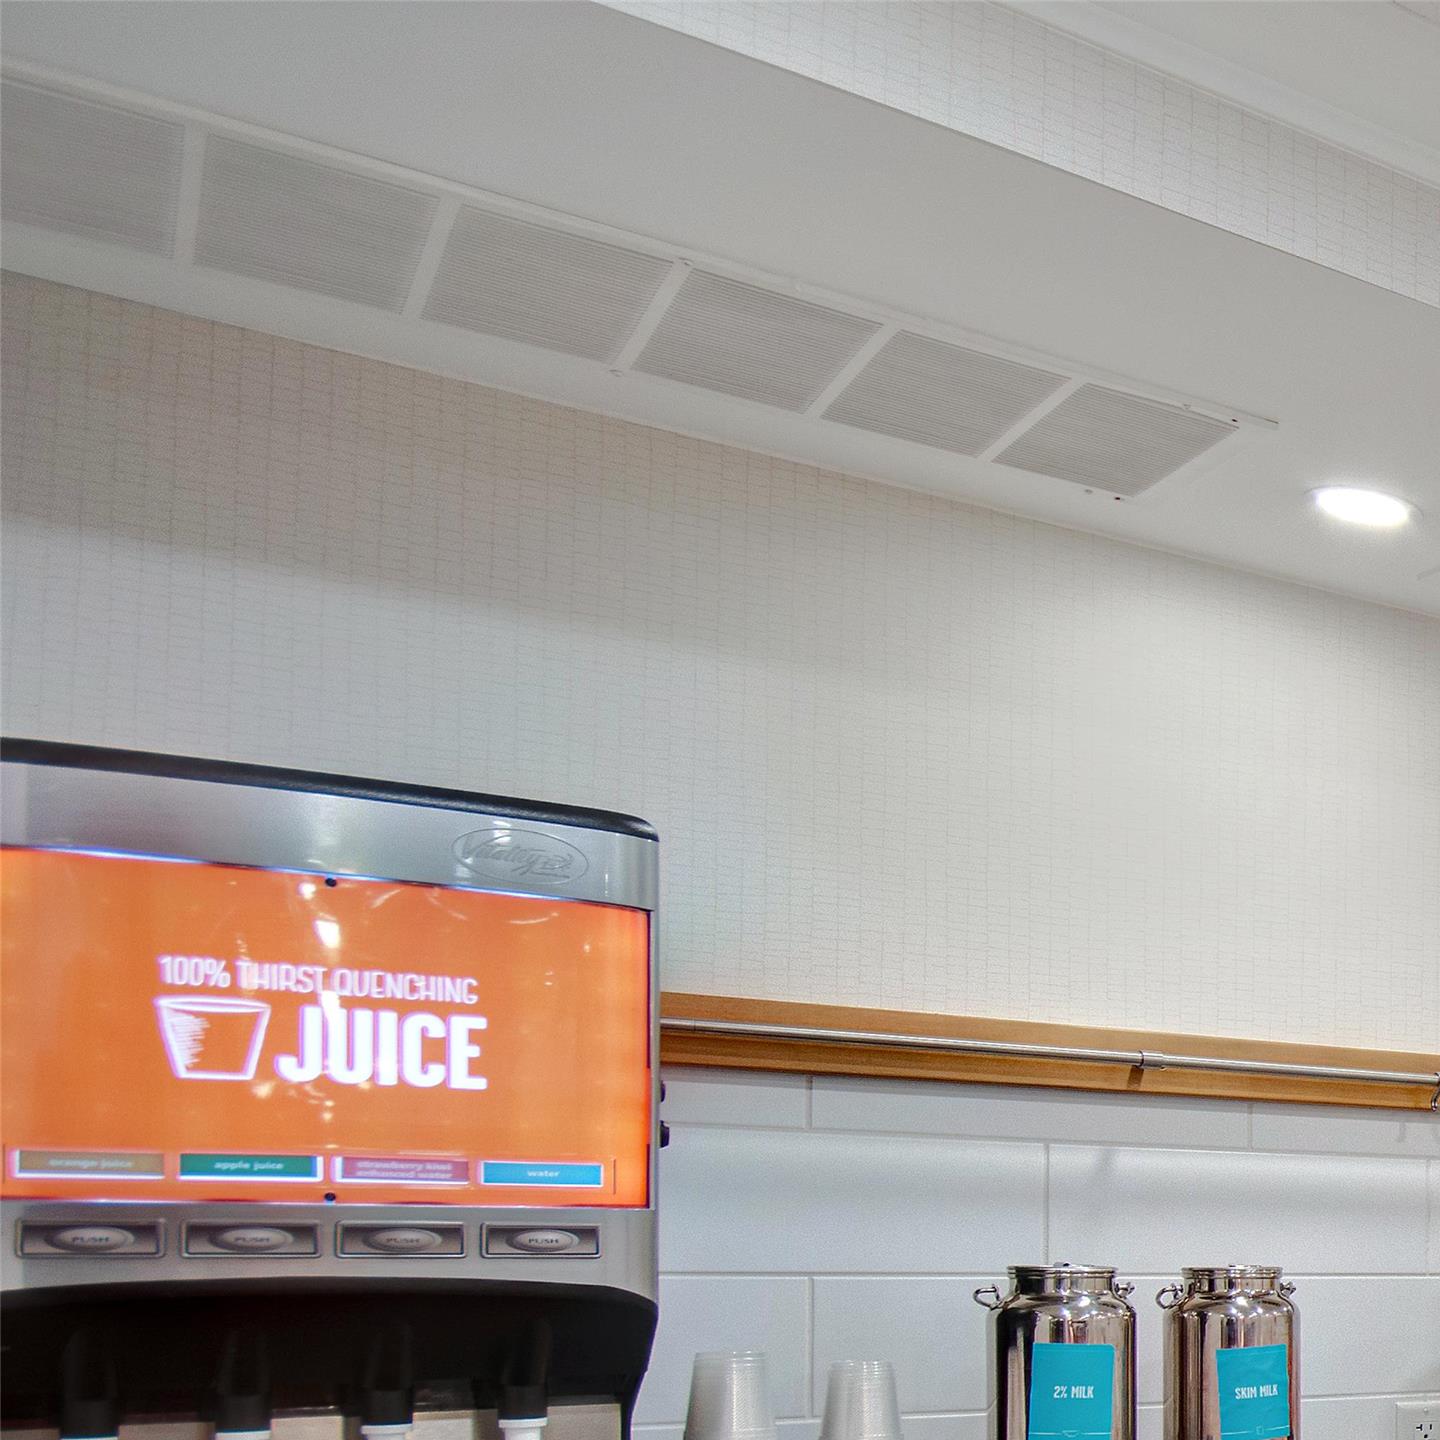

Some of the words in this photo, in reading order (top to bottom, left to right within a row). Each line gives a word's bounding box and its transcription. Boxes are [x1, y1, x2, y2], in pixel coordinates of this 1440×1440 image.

[158, 955, 231, 988] 100%
[236, 958, 328, 993] THIRST
[332, 967, 479, 1005] QUENCHING
[275, 1005, 488, 1090] JUICE
[214, 1161, 250, 1172] apple
[253, 1160, 285, 1171] juice
[527, 1169, 561, 1177] water
[72, 1235, 110, 1243] PUSH
[1053, 1385, 1068, 1399] 2%
[1071, 1386, 1095, 1399] MILK
[1235, 1387, 1258, 1400] SKIM
[1259, 1384, 1278, 1398] MILK
